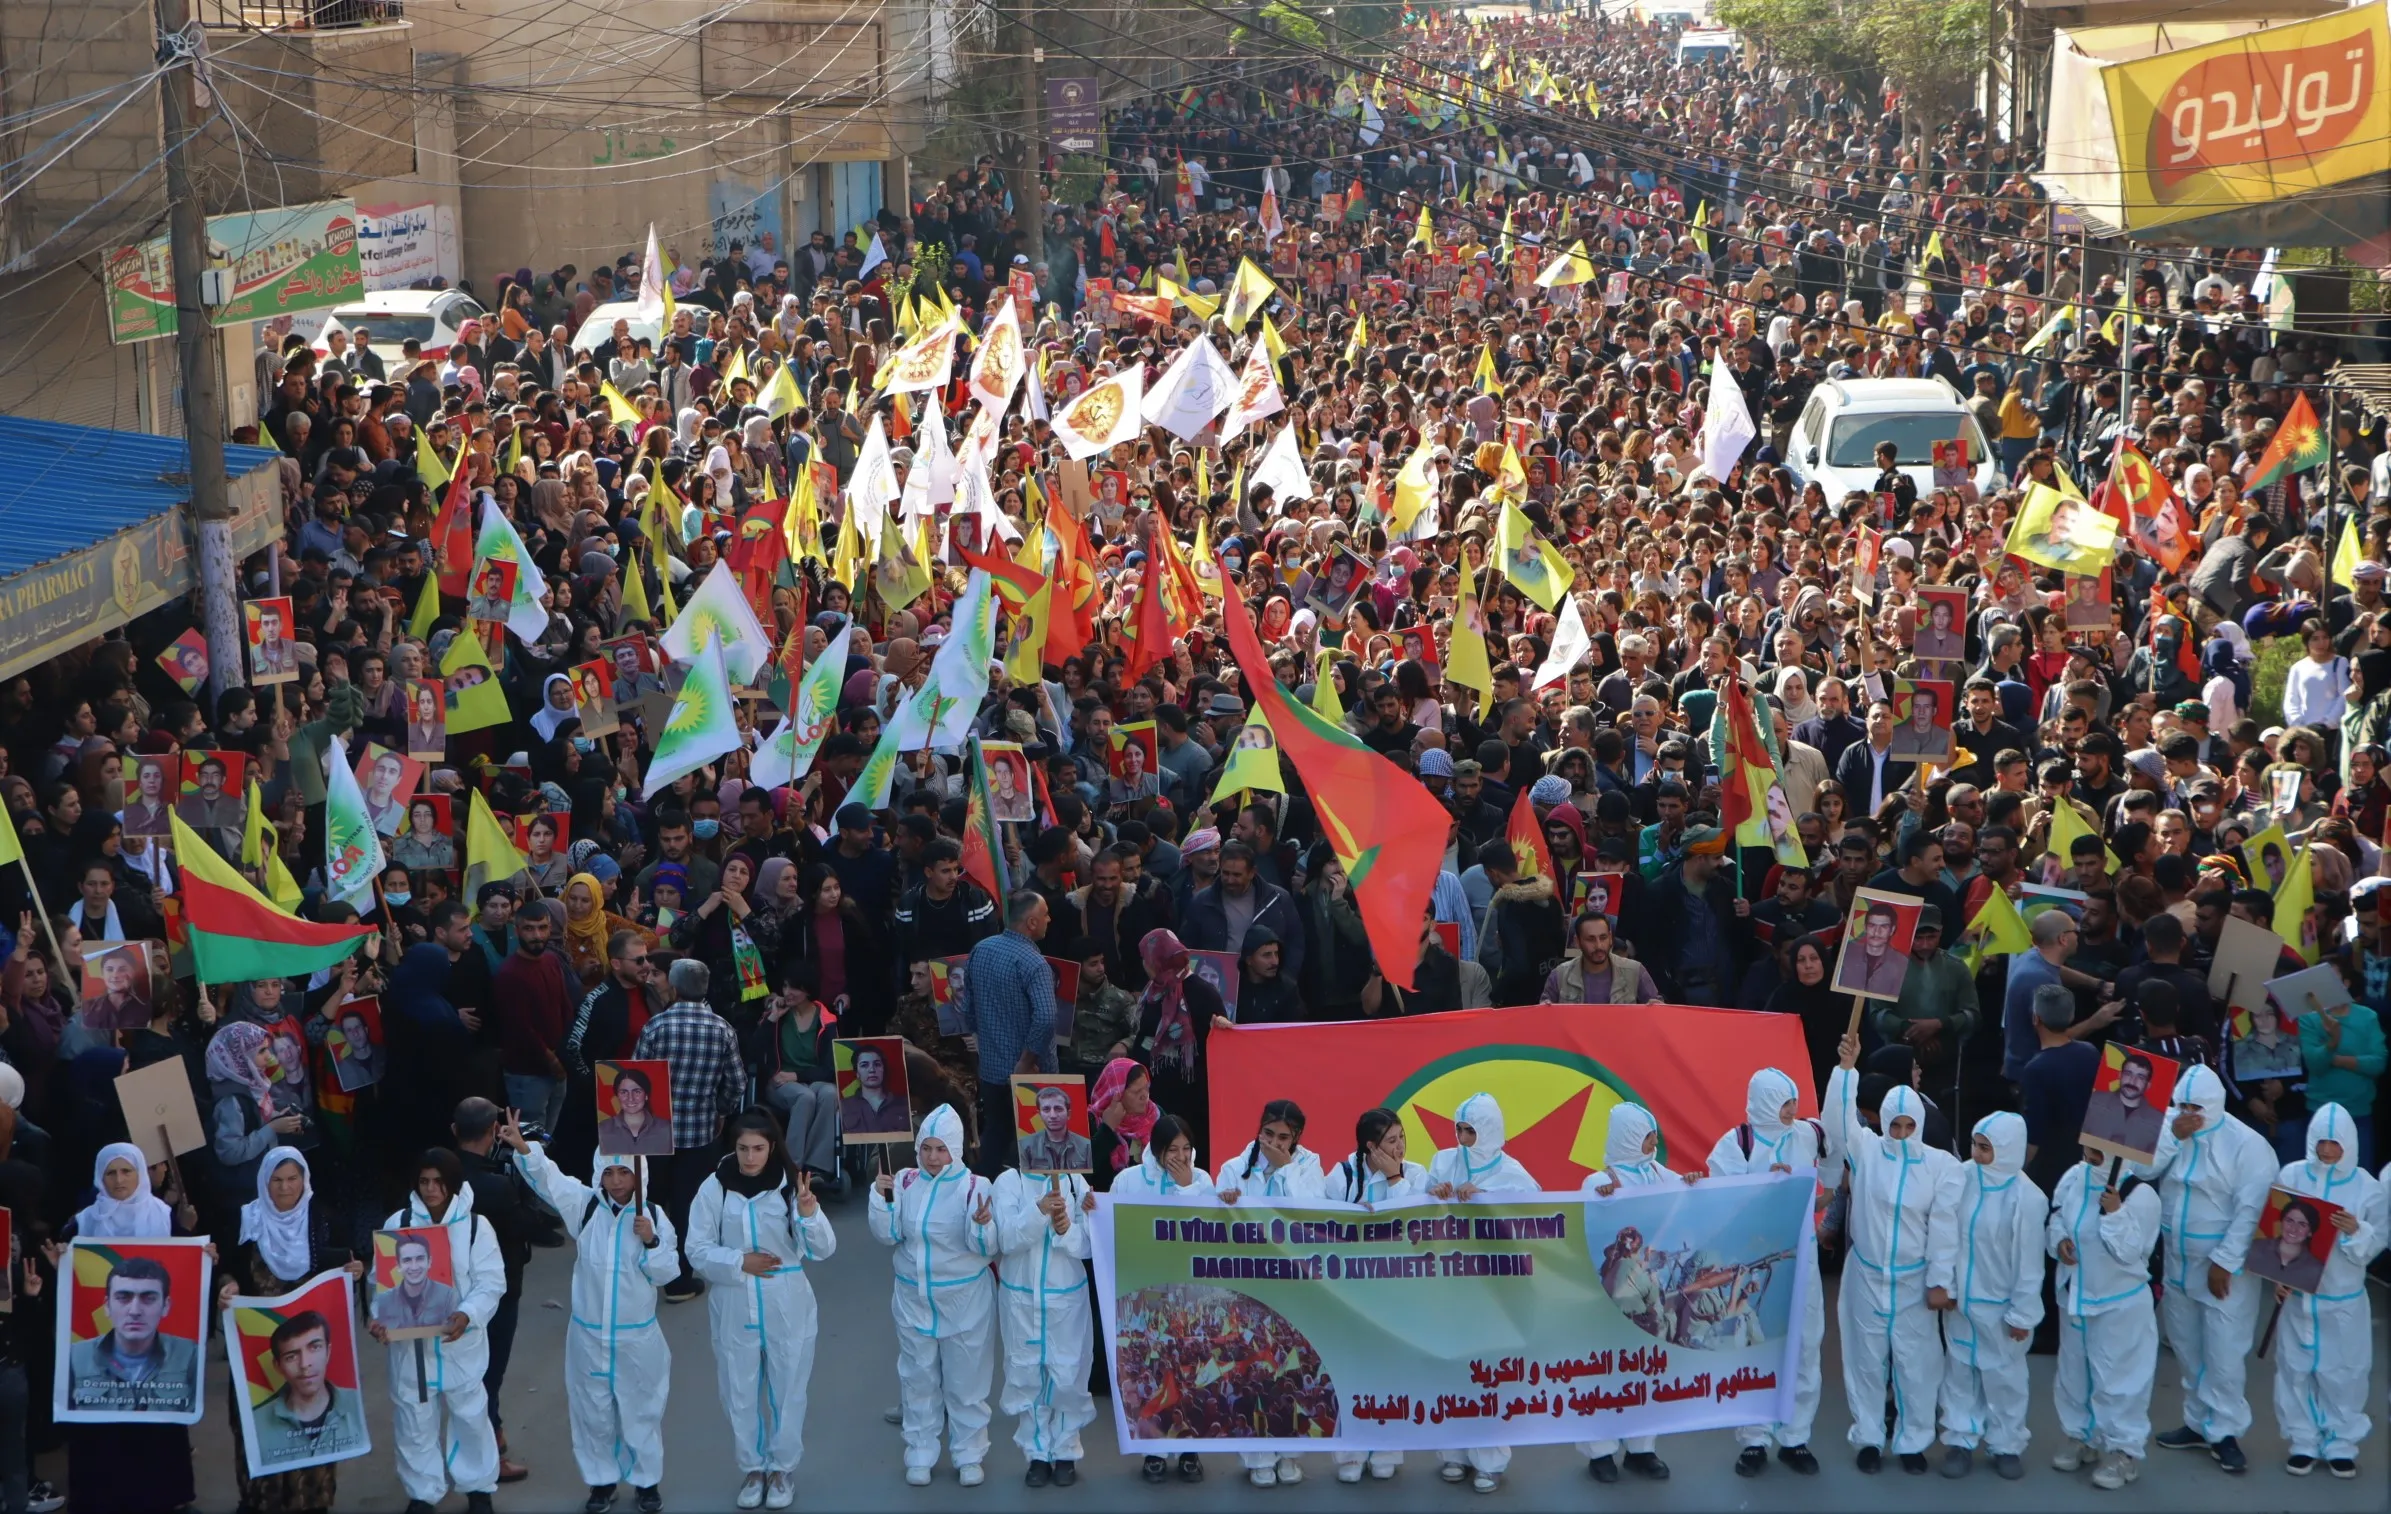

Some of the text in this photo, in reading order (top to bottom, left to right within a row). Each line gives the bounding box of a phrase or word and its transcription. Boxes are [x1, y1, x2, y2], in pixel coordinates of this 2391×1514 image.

[2170, 47, 2364, 164] توليدو
[328, 226, 354, 248] KHOSH
[325, 264, 361, 295] مخزن
[16, 558, 96, 614] PHARMACY
[1155, 1219, 1176, 1241] BI
[1180, 1217, 1228, 1243] VÎNA
[1363, 1218, 1403, 1242] EMÊ
[1407, 1214, 1470, 1245] ÇEKÊN
[1344, 1251, 1436, 1279] XIYANETÊ
[1439, 1250, 1533, 1277] TÊKBIBIN
[1469, 1356, 1525, 1388] الكريلا
[1528, 1361, 1540, 1386] و
[1544, 1349, 1613, 1383] الشعوب
[83, 1379, 130, 1389] Demhat
[1568, 1380, 1647, 1416] الكيماوية
[1715, 1366, 1777, 1403] سنقاوم
[1352, 1394, 1410, 1426] الخيانة
[1413, 1400, 1425, 1425] و
[1430, 1391, 1498, 1424] الاحتلال
[1501, 1389, 1548, 1422] ندحر
[1551, 1394, 1564, 1418] و
